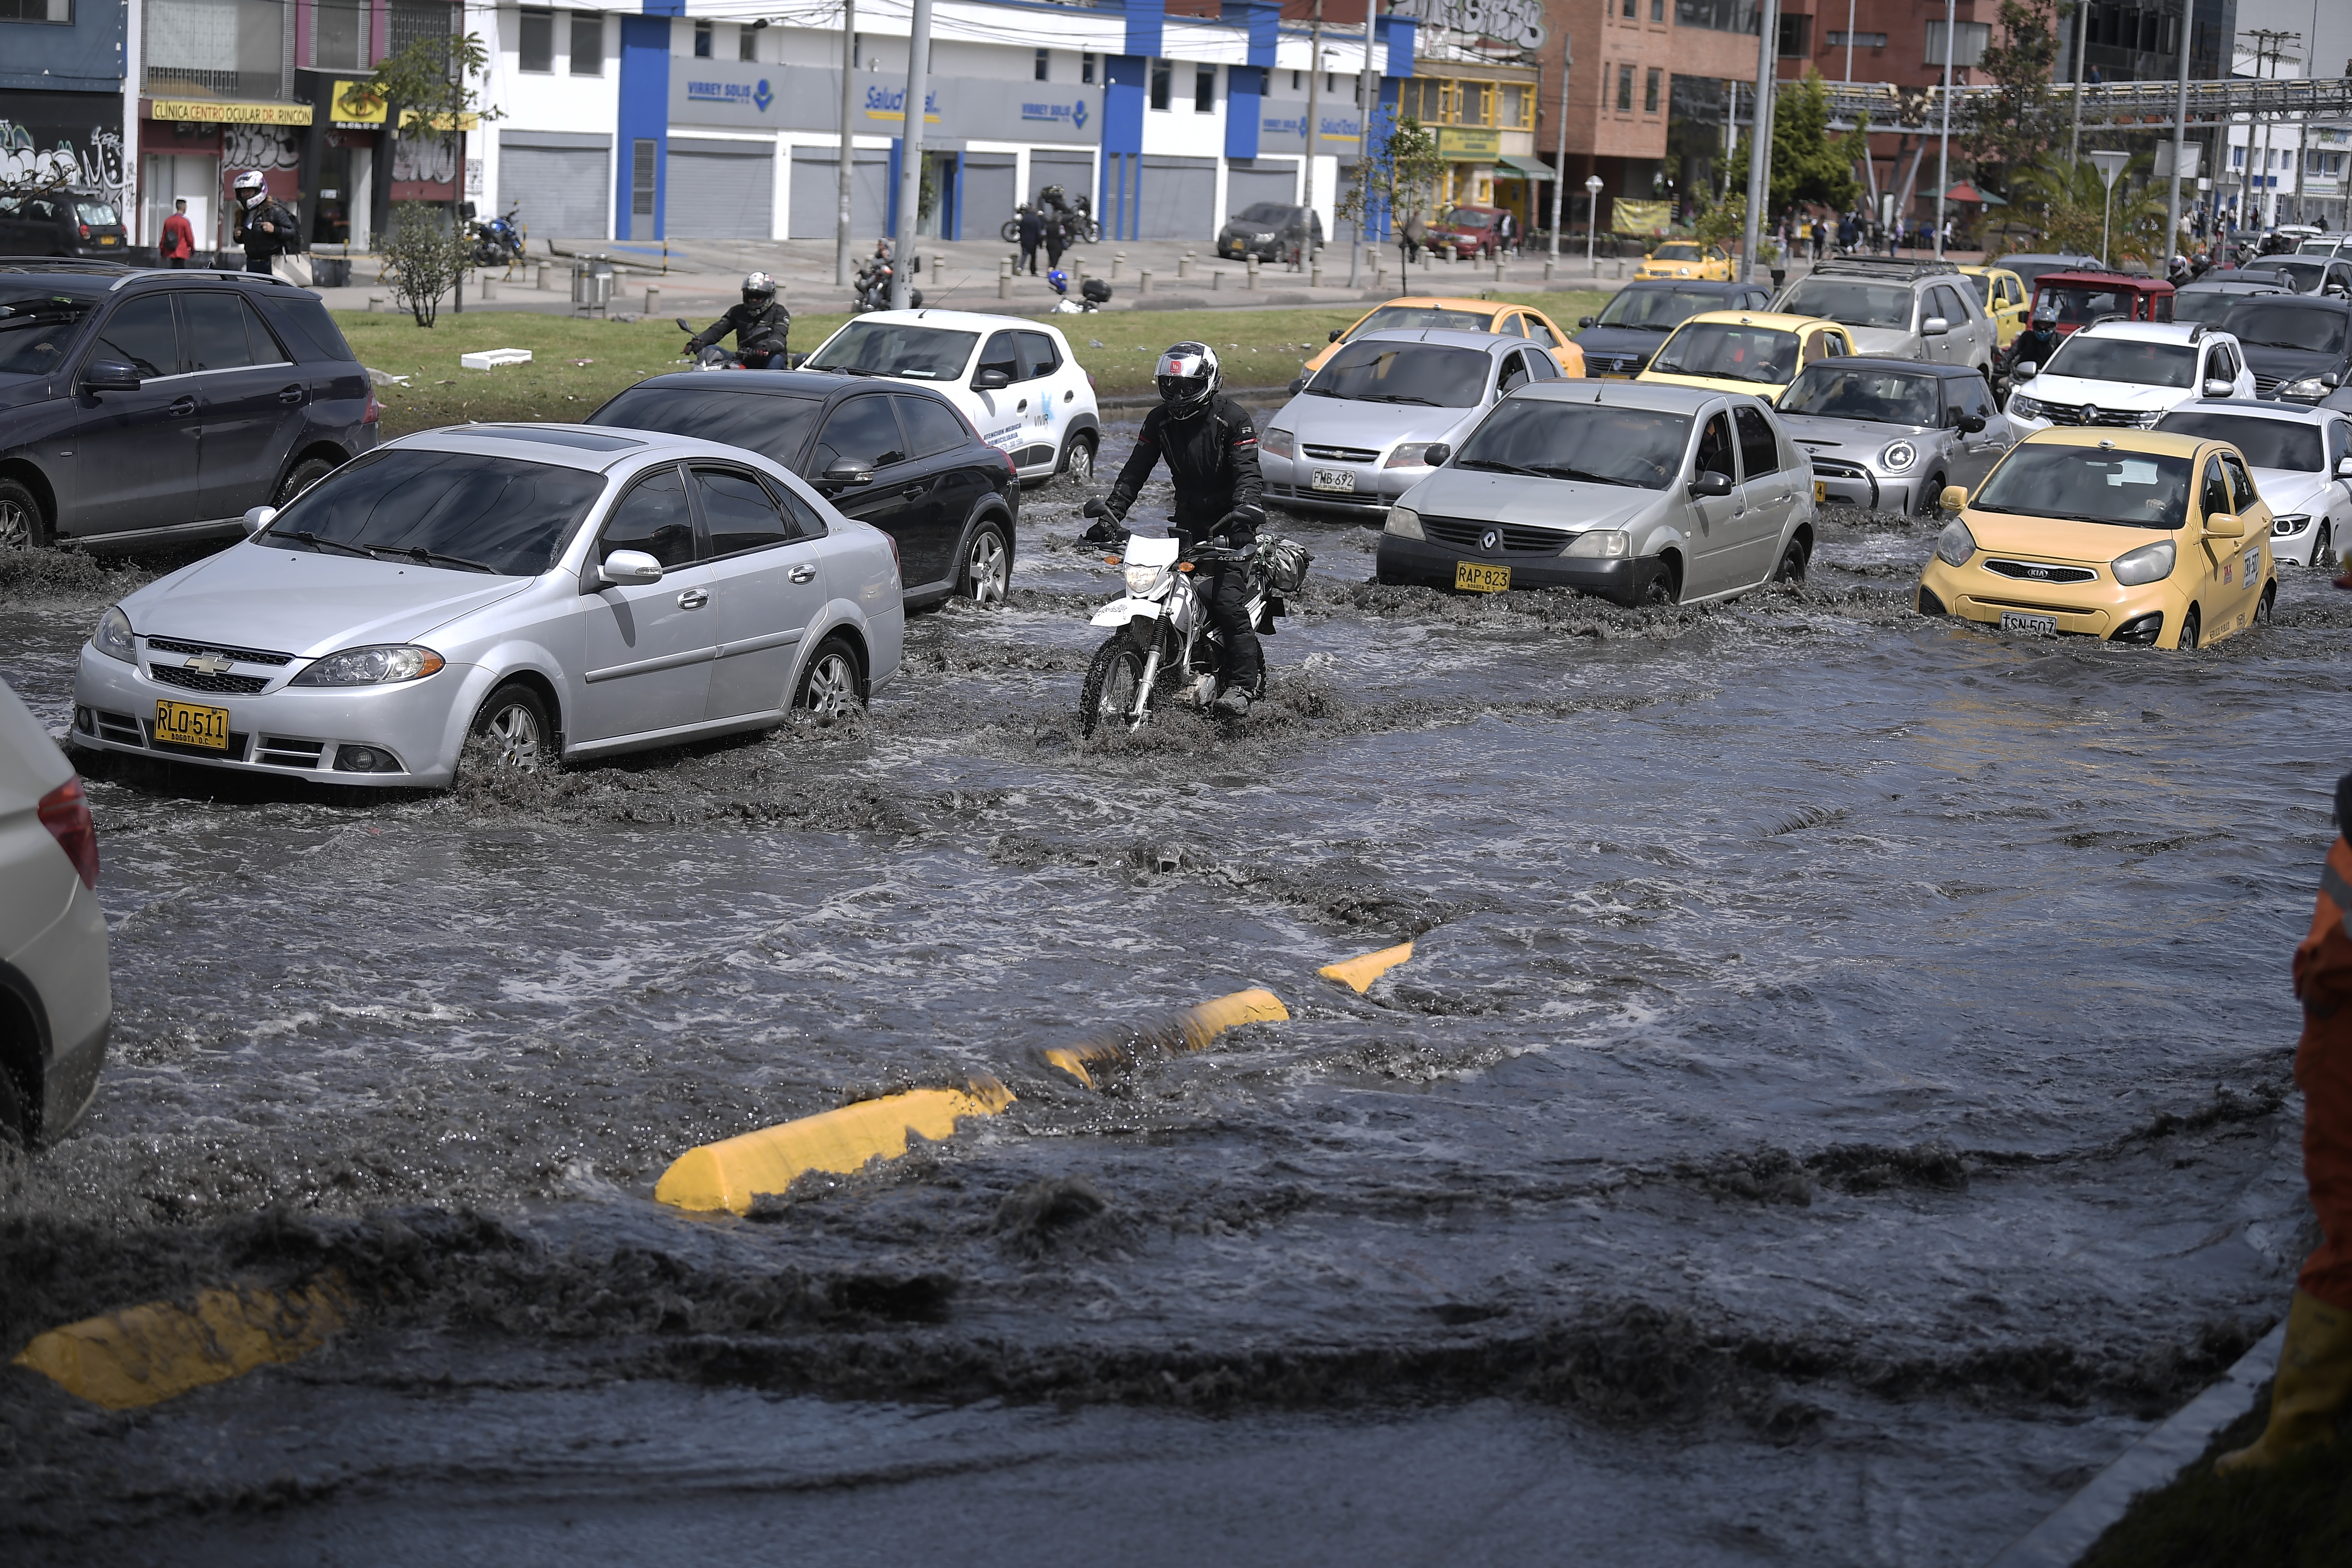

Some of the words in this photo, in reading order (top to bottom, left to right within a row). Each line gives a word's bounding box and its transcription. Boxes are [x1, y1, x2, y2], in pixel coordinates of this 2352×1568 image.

[689, 82, 721, 95] VIRREY
[726, 84, 750, 97] SOLIS
[191, 104, 225, 120] CENTRO
[226, 107, 261, 121] OCULAR
[263, 109, 276, 122] DR.
[983, 427, 1004, 440] ATENCION
[1005, 422, 1021, 433] MEDICA
[988, 432, 1018, 446] DOMICILIARIA
[1314, 471, 1332, 484] FMB
[1335, 474, 1353, 487] 692
[1458, 567, 1482, 583] RAP
[1485, 570, 1508, 587] 823
[158, 707, 189, 732] RLO
[193, 712, 224, 738] 511
[172, 733, 195, 743] BOGOTA
[199, 737, 210, 745] D.C.
